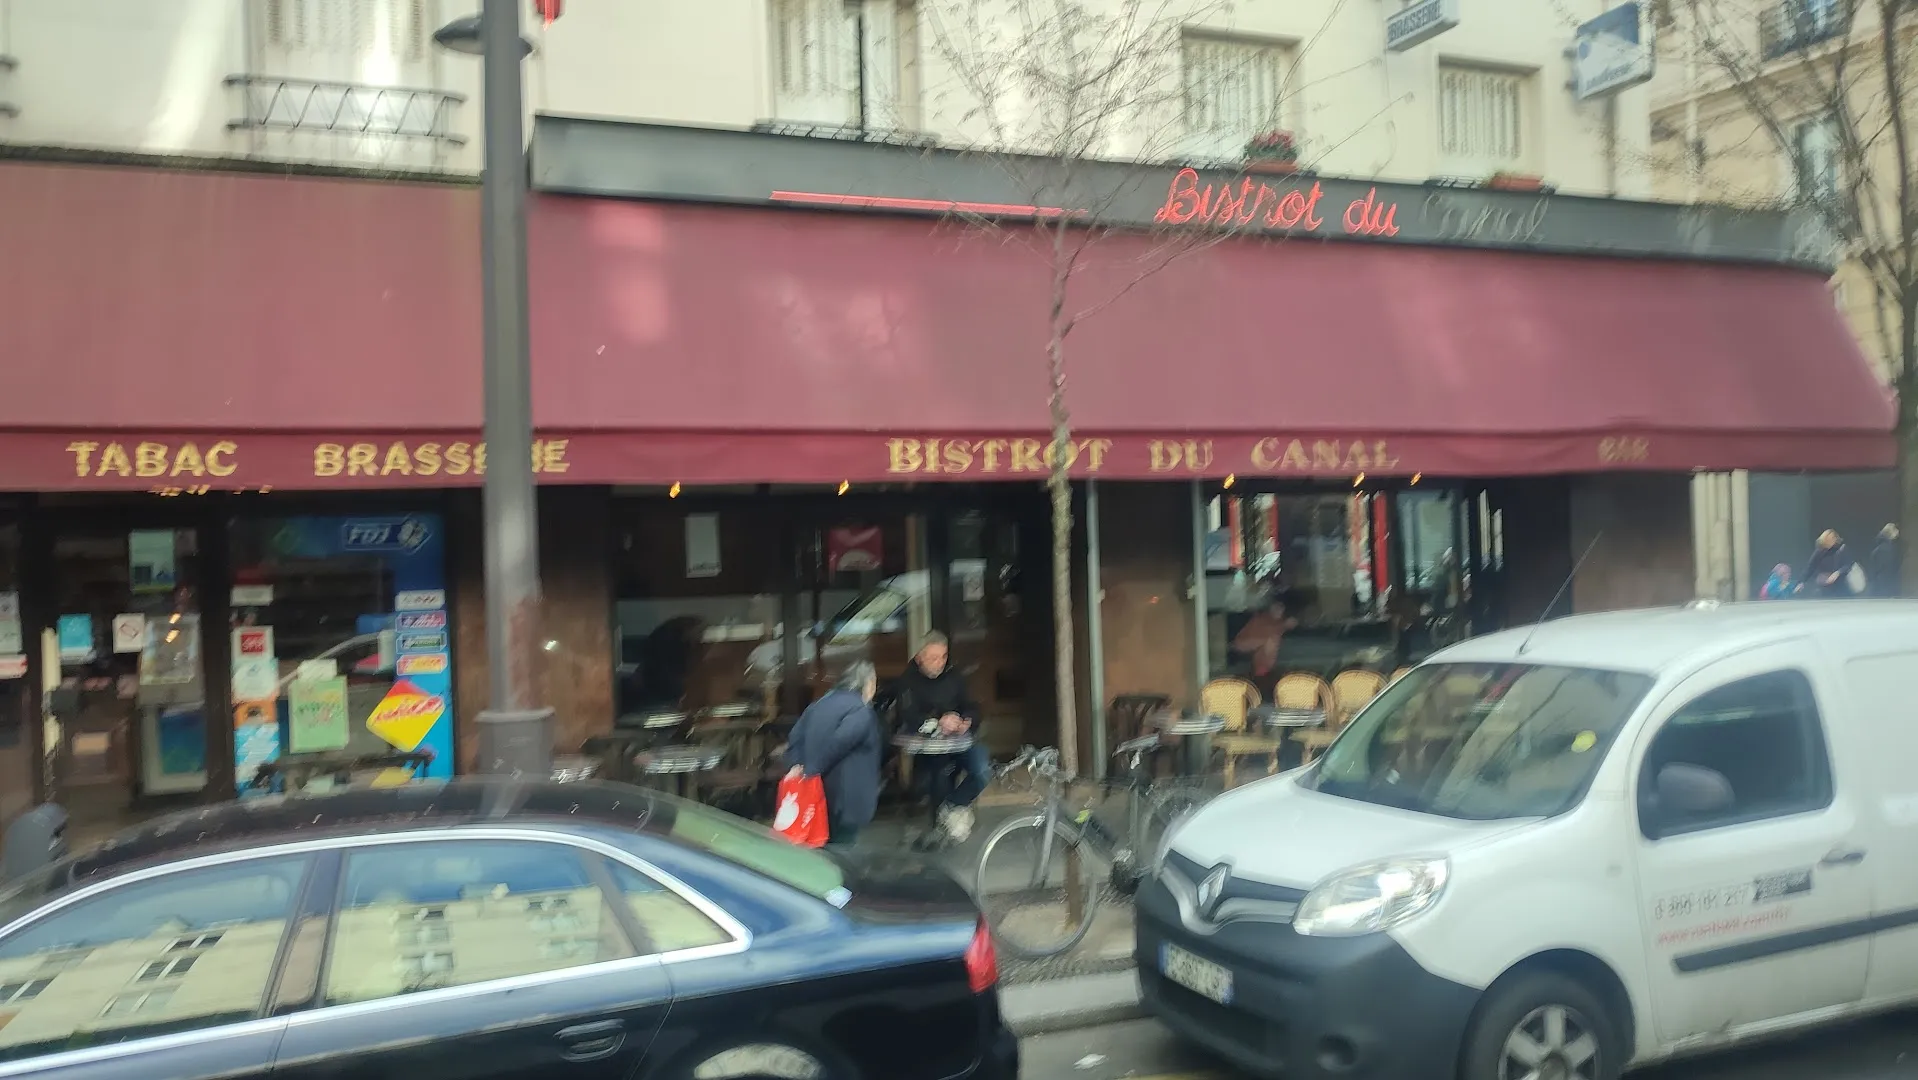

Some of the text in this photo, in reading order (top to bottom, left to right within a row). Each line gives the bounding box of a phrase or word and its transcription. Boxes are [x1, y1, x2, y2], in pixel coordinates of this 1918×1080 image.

[1154, 167, 1325, 232] Bistrot
[1343, 186, 1400, 238] du
[65, 440, 238, 477] TABAC
[313, 439, 570, 476] BRASSEIE
[885, 436, 1399, 474] BISTROT DU CANAL
